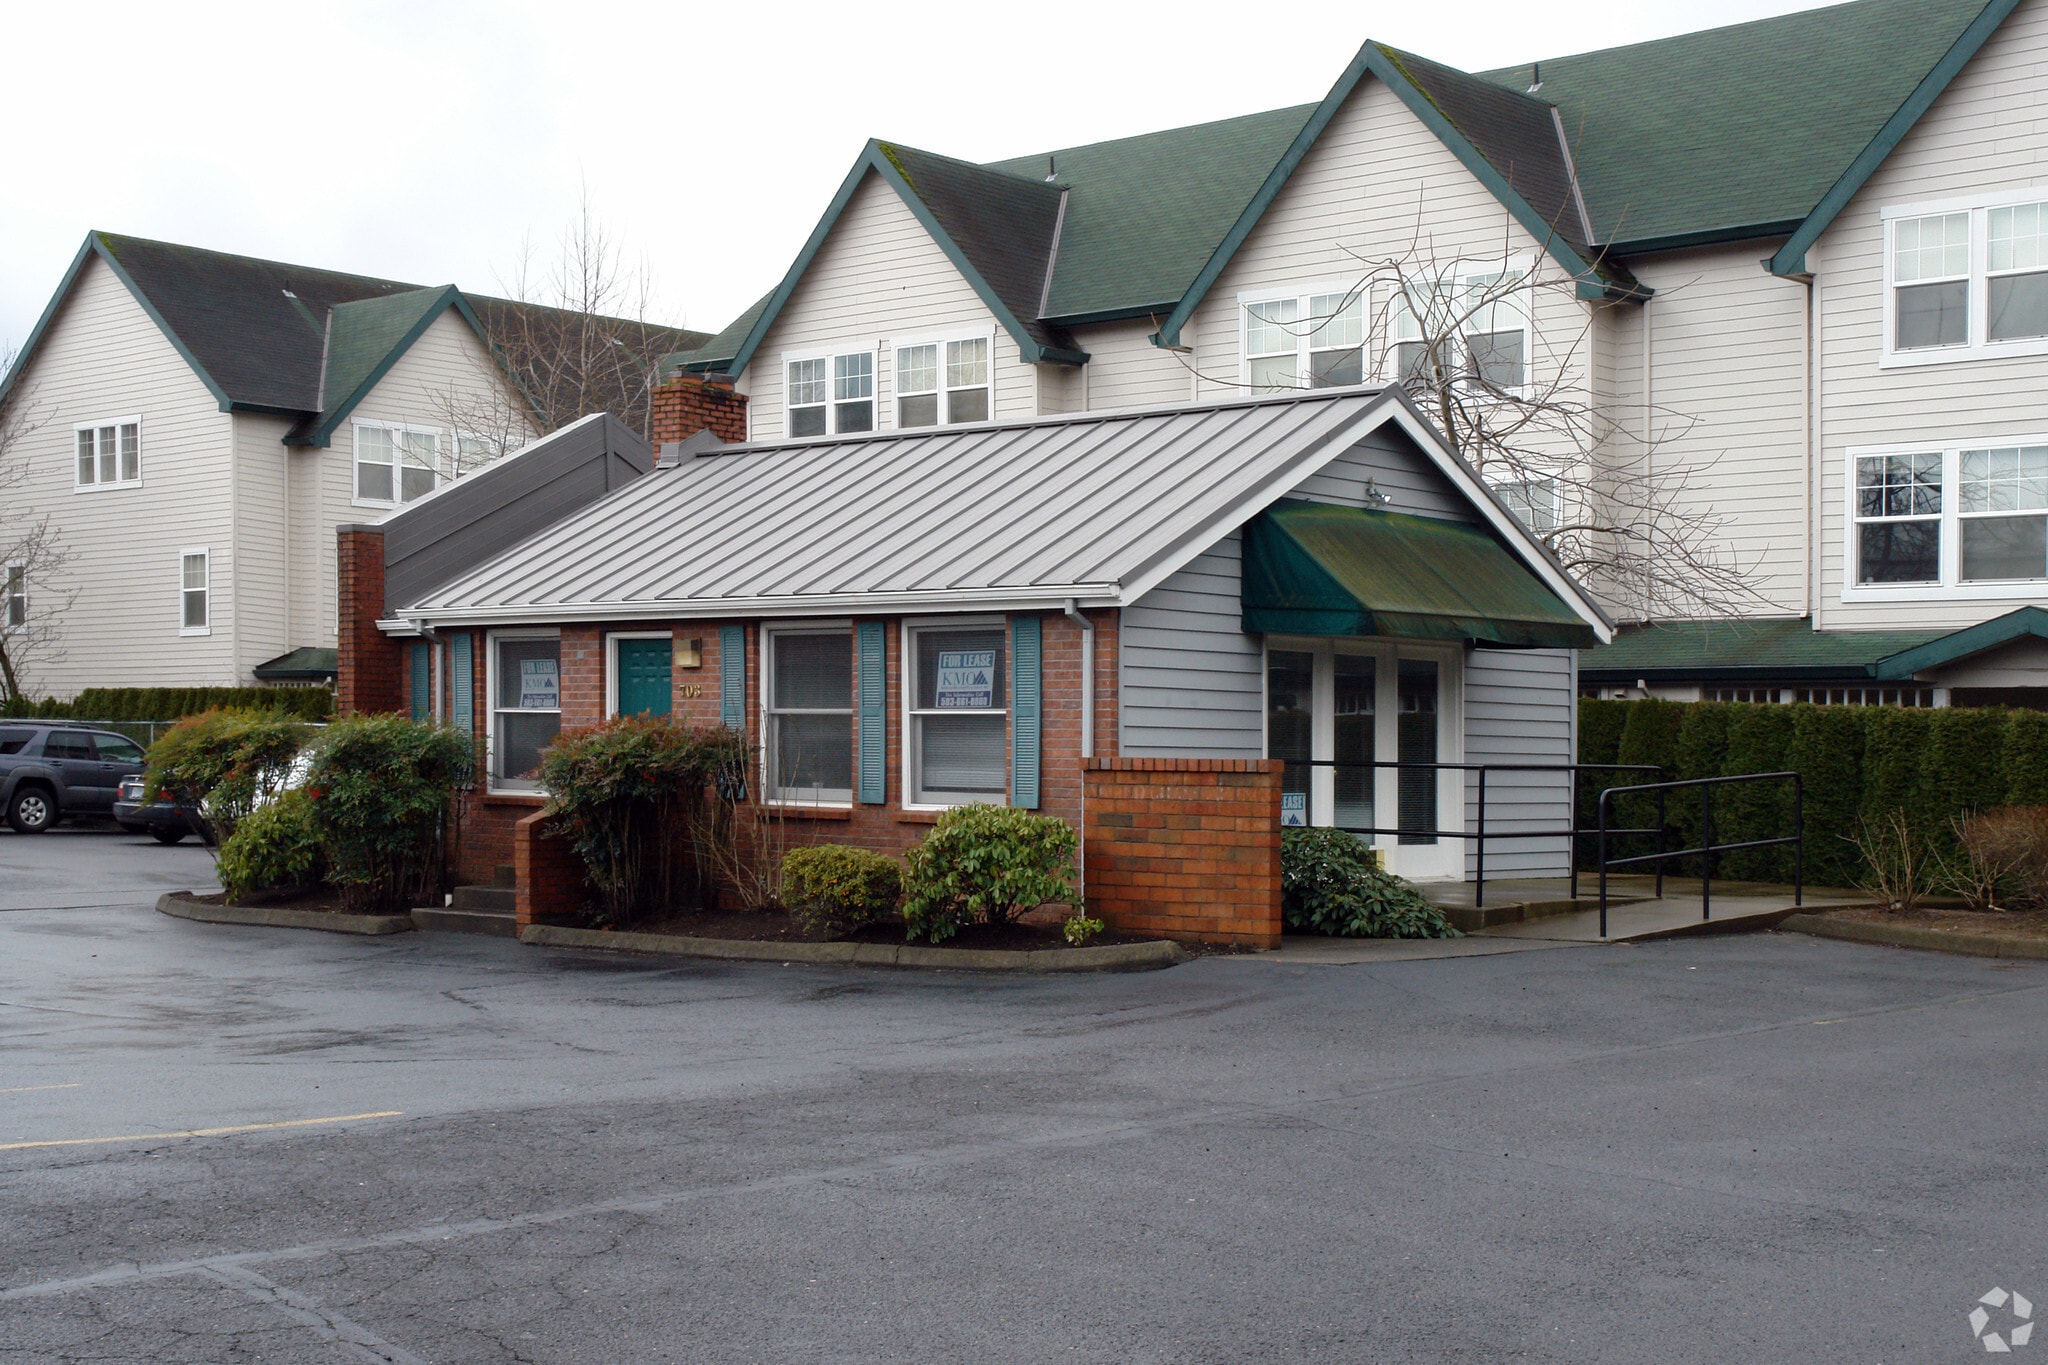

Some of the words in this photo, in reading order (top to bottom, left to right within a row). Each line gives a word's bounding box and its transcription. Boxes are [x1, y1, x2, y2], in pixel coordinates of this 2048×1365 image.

[942, 654, 961, 667] FOR
[963, 653, 992, 667] LEASE
[679, 684, 701, 698] 703
[1282, 795, 1303, 809] EASE
